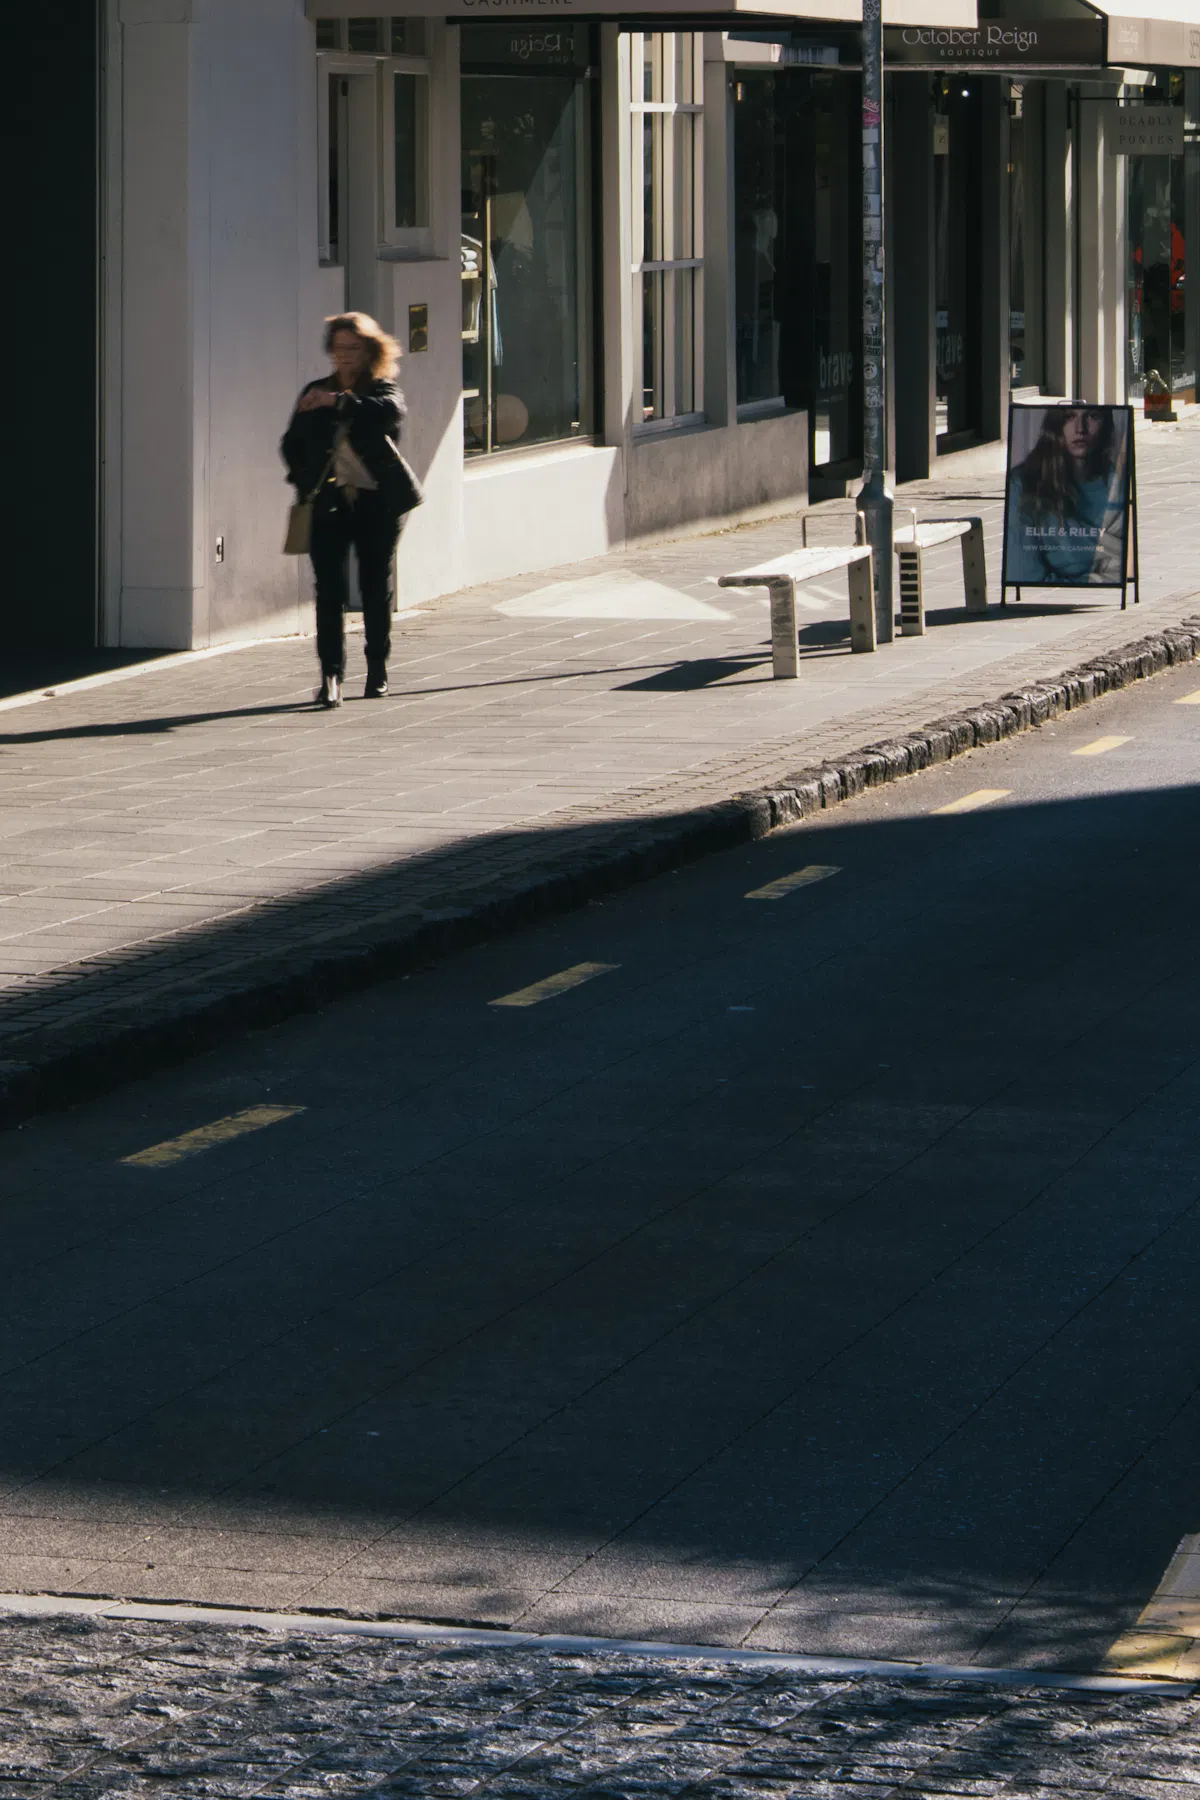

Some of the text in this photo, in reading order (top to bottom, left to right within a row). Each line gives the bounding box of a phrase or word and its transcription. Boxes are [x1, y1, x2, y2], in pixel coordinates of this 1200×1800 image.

[902, 25, 1038, 52] October Reign
[940, 48, 1001, 58] BOUTIQUE
[1119, 115, 1174, 126] DEADLY
[1119, 134, 1174, 145] PONIES
[820, 345, 853, 390] brave
[1025, 527, 1106, 537] ELLE & RILEY
